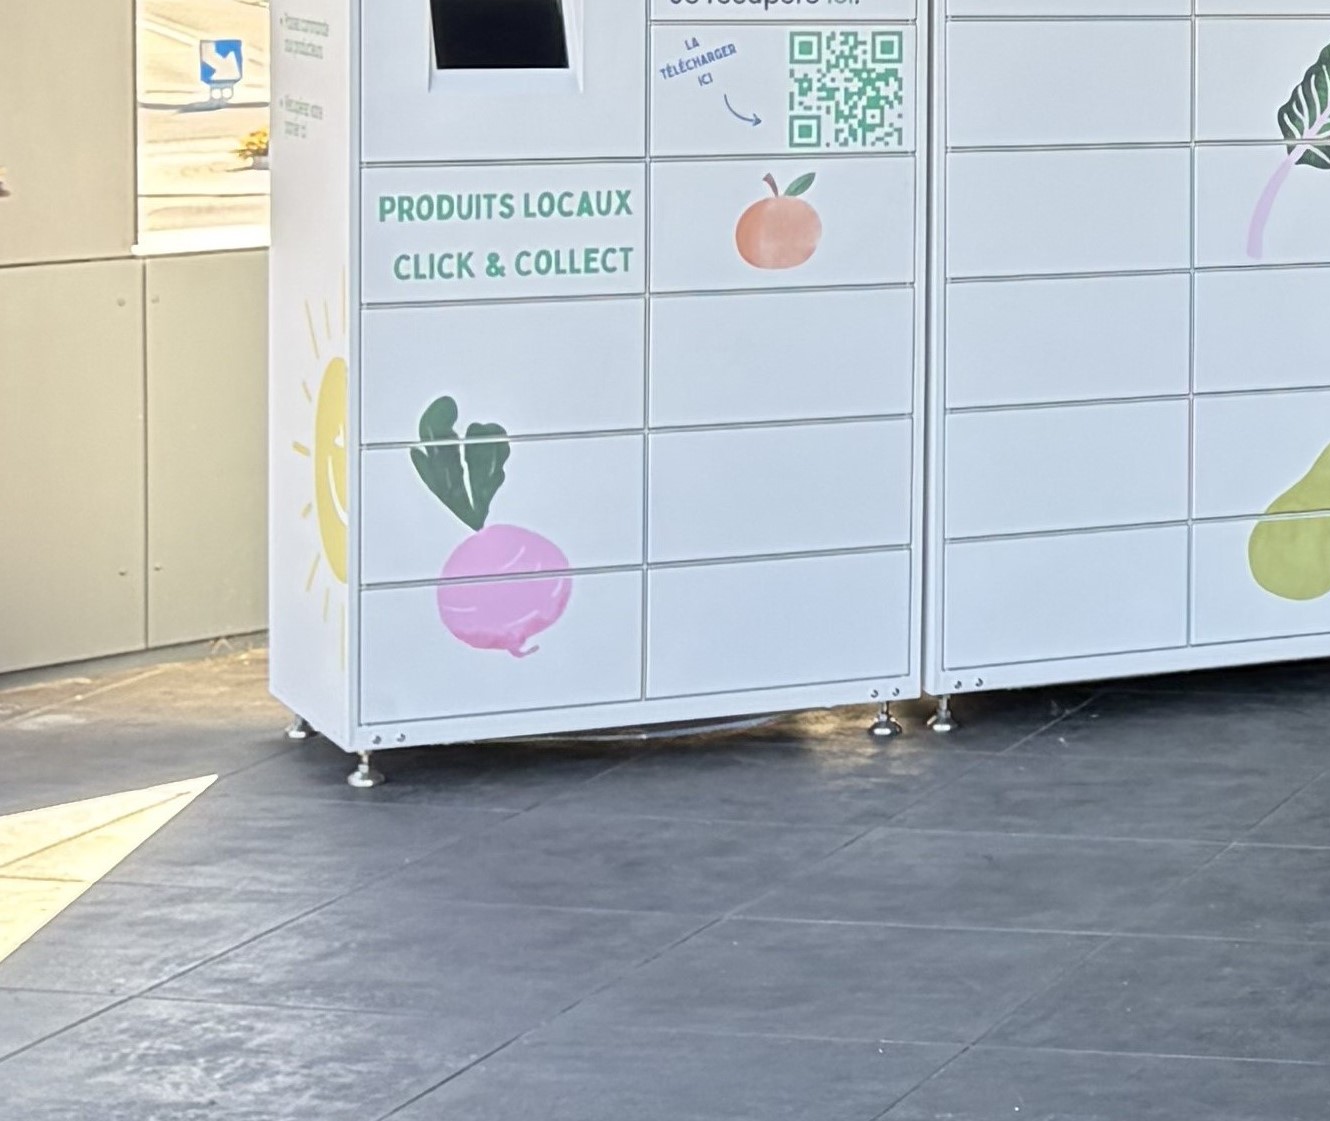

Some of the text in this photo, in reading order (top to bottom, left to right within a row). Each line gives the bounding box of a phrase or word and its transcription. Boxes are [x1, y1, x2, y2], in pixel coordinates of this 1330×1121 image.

[684, 37, 700, 51] LA
[659, 43, 737, 81] TÉLÉCHARGER
[697, 72, 714, 87] ICI
[378, 189, 633, 223] PRODUITS LOCAUX
[393, 246, 634, 281] CLICK & COLLECT
